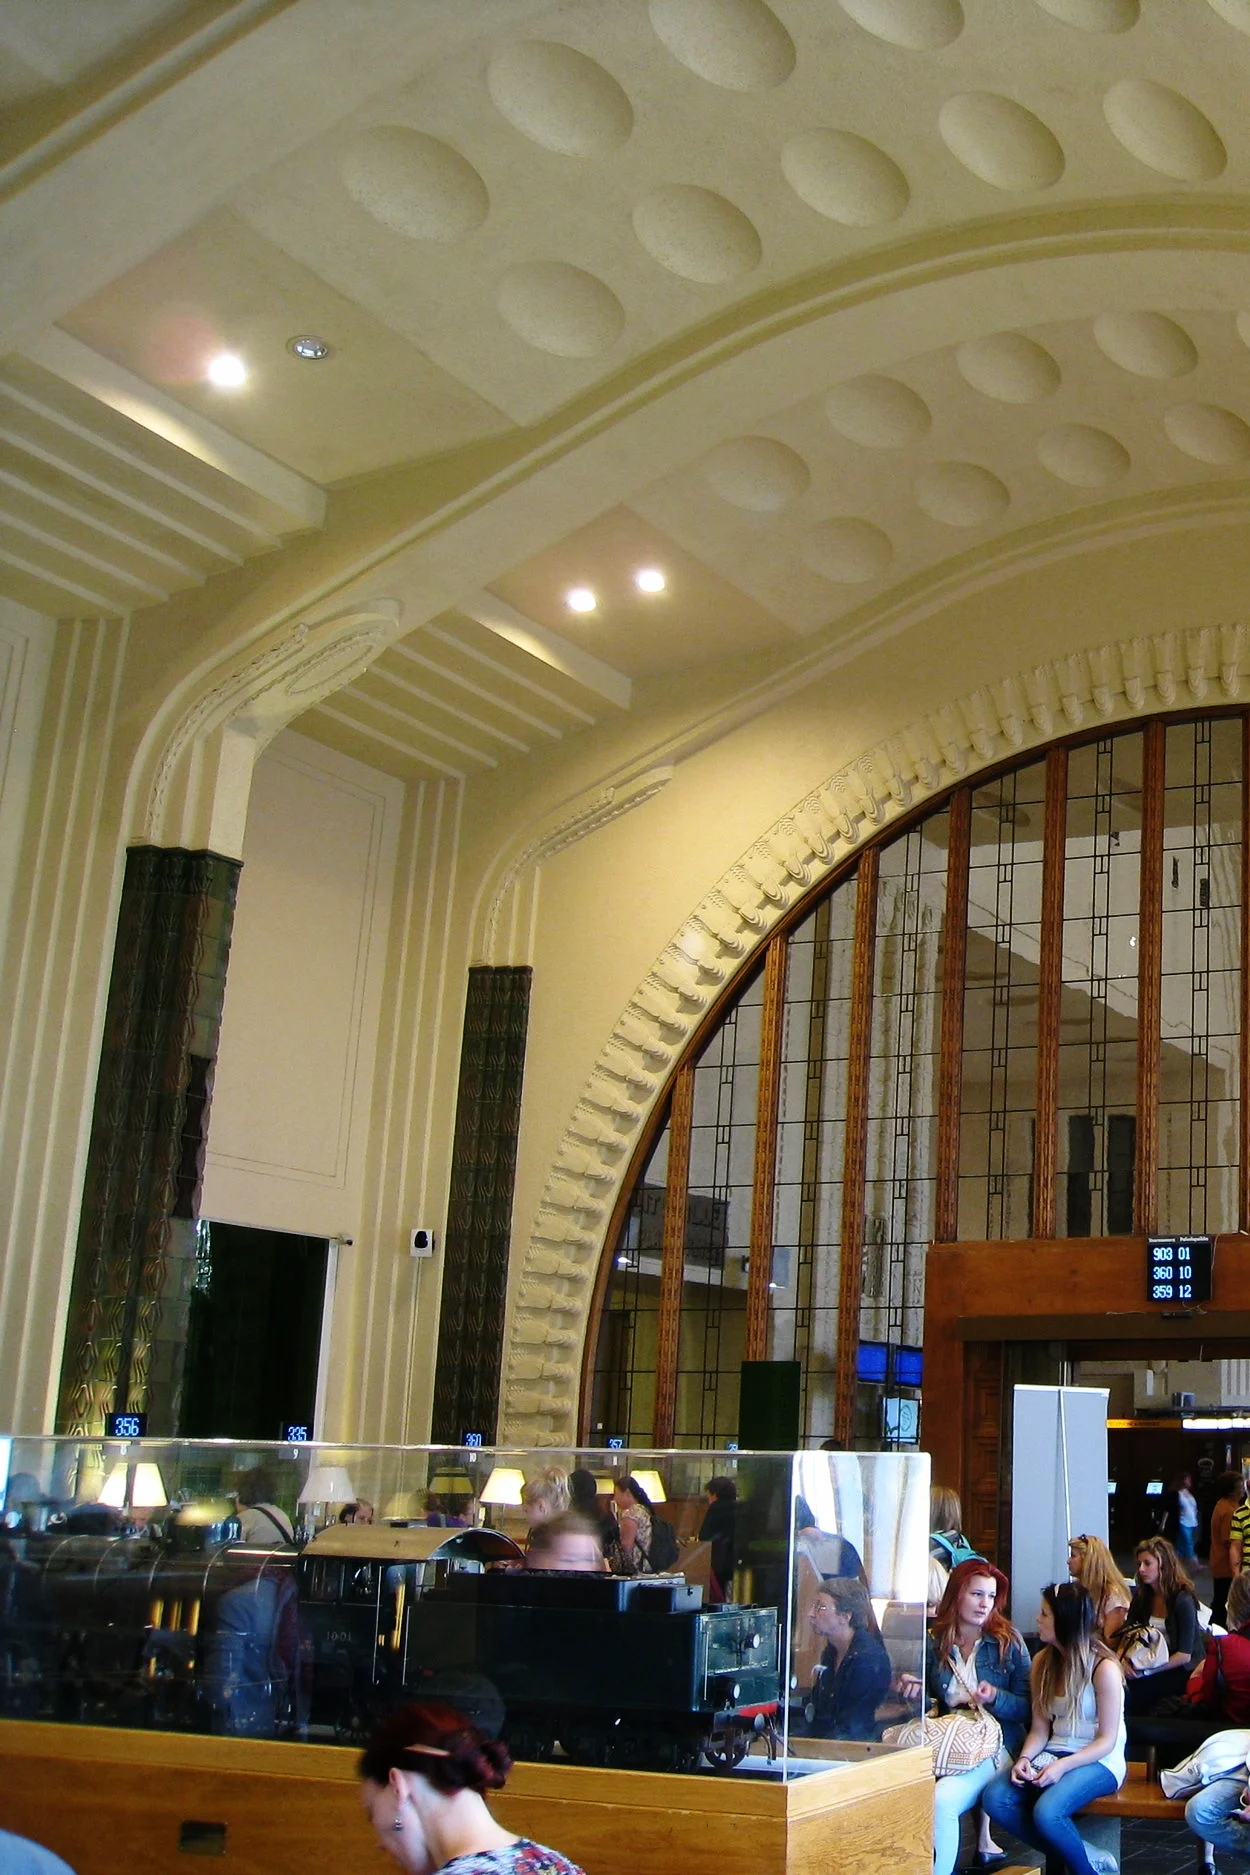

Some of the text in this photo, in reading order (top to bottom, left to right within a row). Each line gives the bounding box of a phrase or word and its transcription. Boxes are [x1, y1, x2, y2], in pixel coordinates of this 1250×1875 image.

[1153, 1247, 1190, 1260] 903 01
[1153, 1266, 1192, 1279] 360 10
[1153, 1284, 1192, 1299] 359 12
[115, 1417, 139, 1436] 356
[287, 1426, 307, 1441] 335
[293, 1448, 299, 1460] 9
